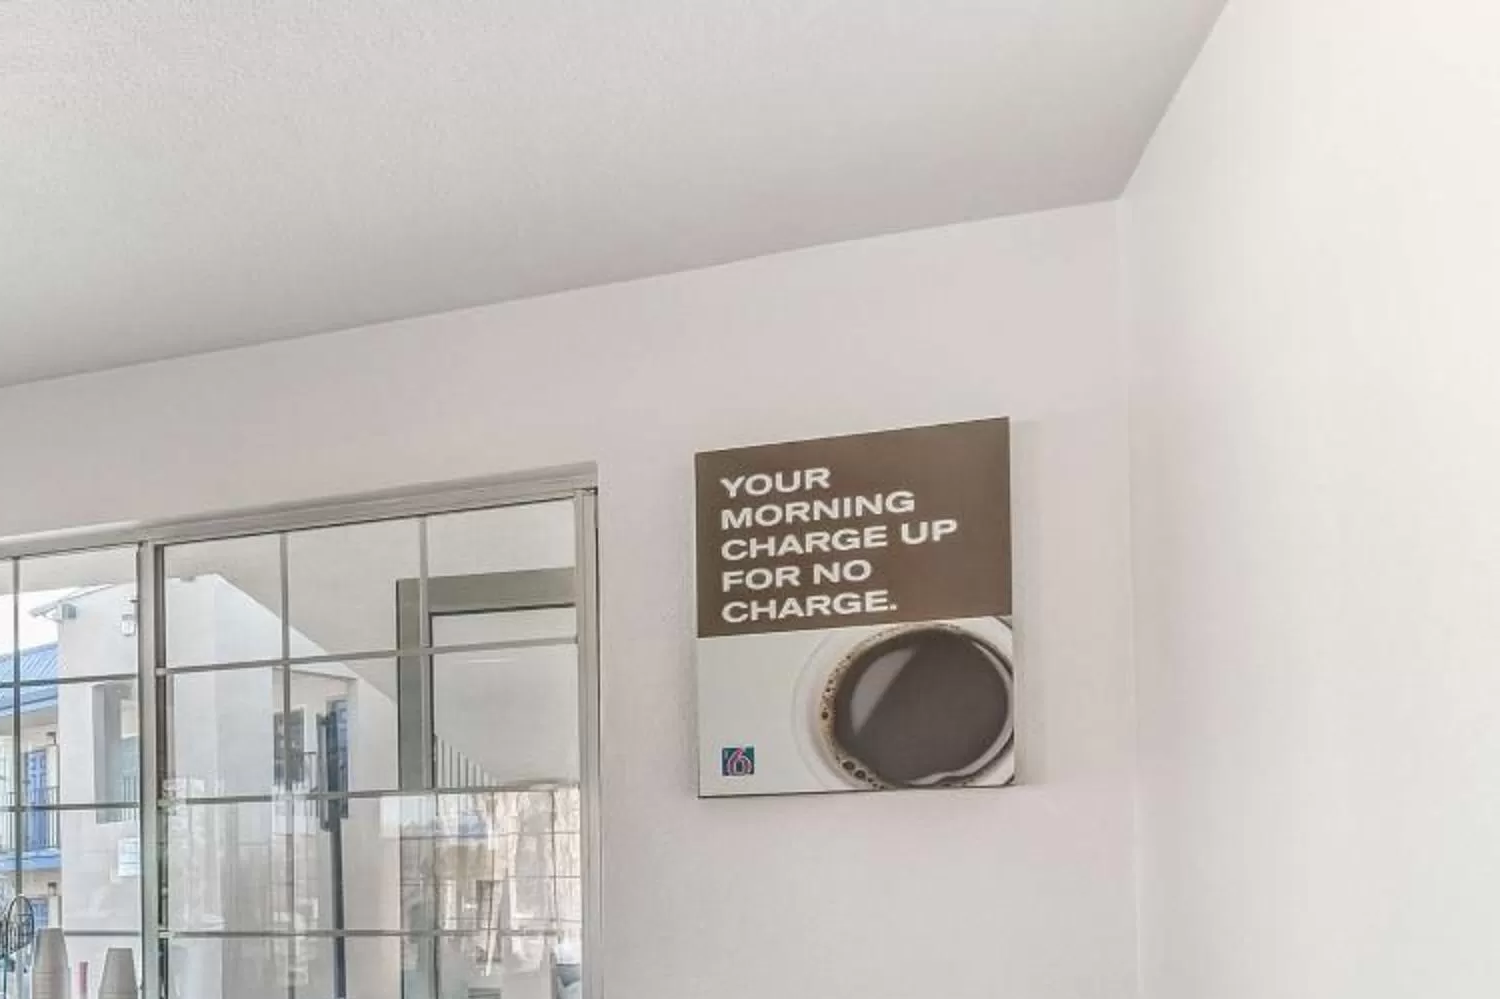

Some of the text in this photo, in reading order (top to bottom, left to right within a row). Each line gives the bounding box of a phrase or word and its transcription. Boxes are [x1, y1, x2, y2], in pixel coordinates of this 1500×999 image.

[720, 467, 832, 499] YOUR
[720, 491, 916, 531] MORNING
[720, 519, 958, 561] CHARGE UP
[721, 559, 872, 593] FOR NO
[721, 589, 898, 623] CHARGE.
